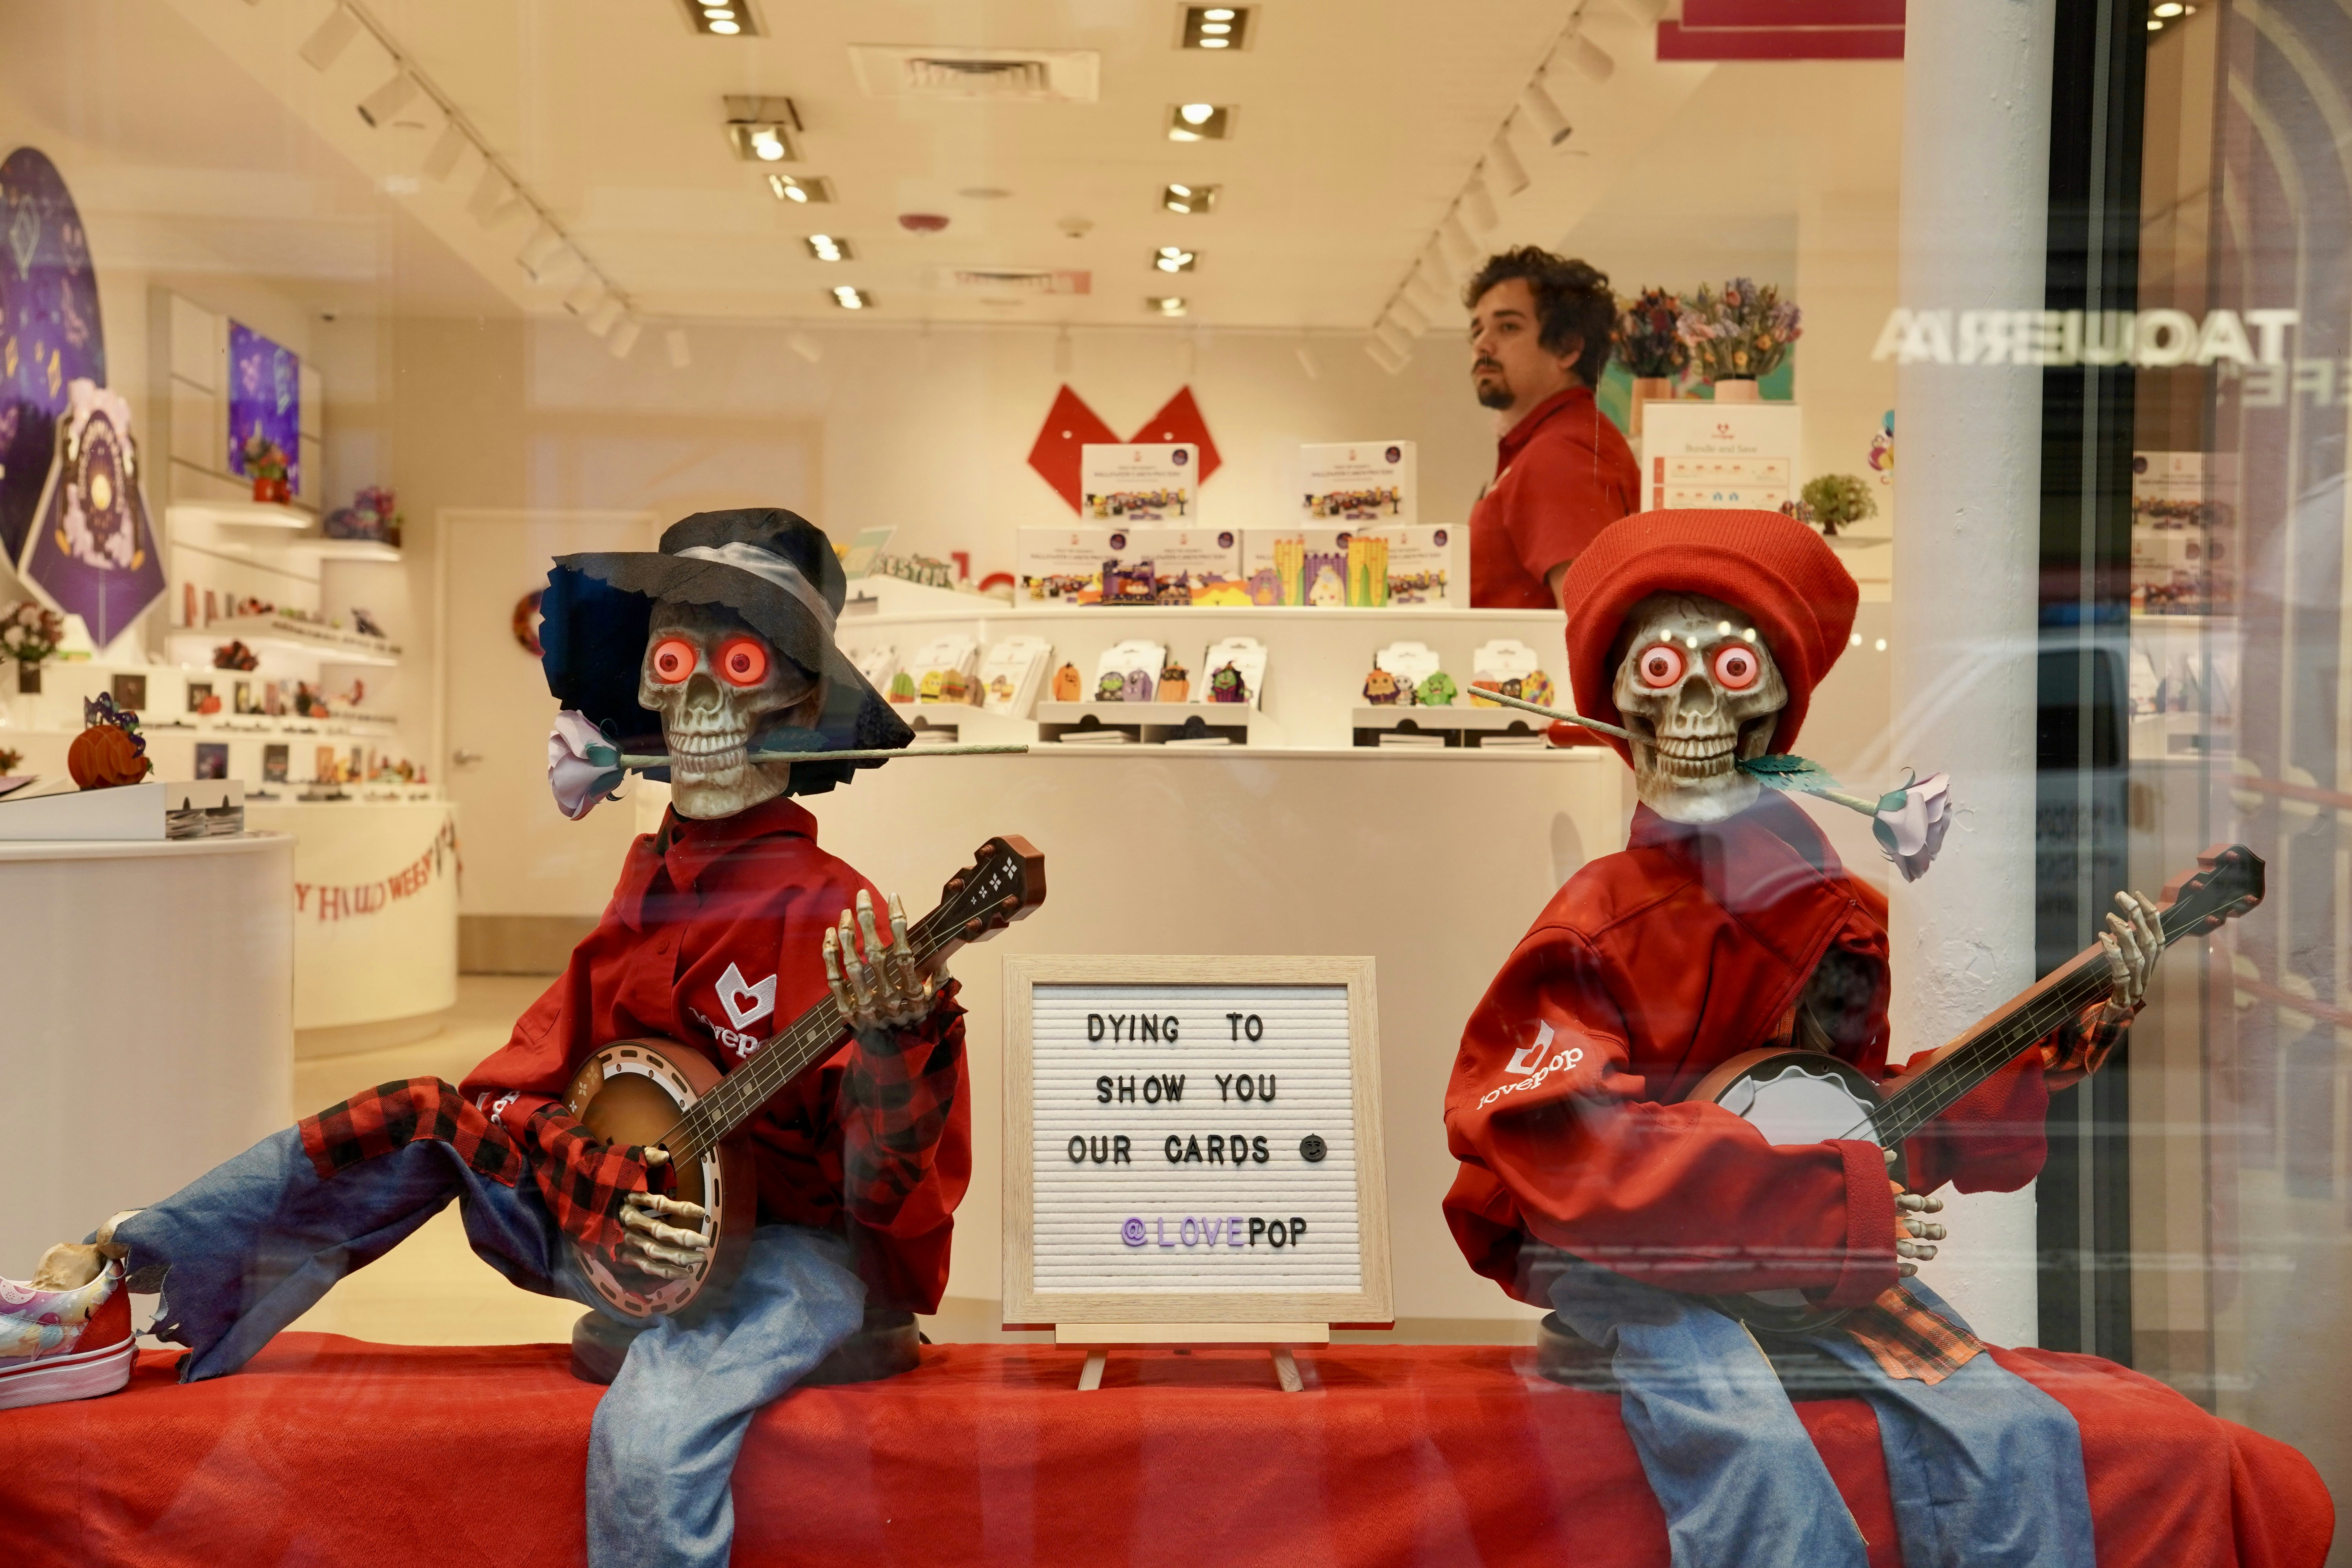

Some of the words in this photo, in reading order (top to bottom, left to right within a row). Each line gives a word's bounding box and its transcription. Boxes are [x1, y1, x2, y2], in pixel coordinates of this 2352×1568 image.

[1686, 444, 1715, 452] Bundle
[1087, 1013, 1180, 1042] DYING
[1226, 1012, 1263, 1042] TO
[1096, 1074, 1185, 1103] SHOW
[1215, 1074, 1276, 1102] YOU
[1476, 1047, 1584, 1110] lovepop
[1068, 1134, 1131, 1163] OUR
[1165, 1134, 1270, 1165] CARDS
[1121, 1216, 1307, 1248] @LOVEPOP
